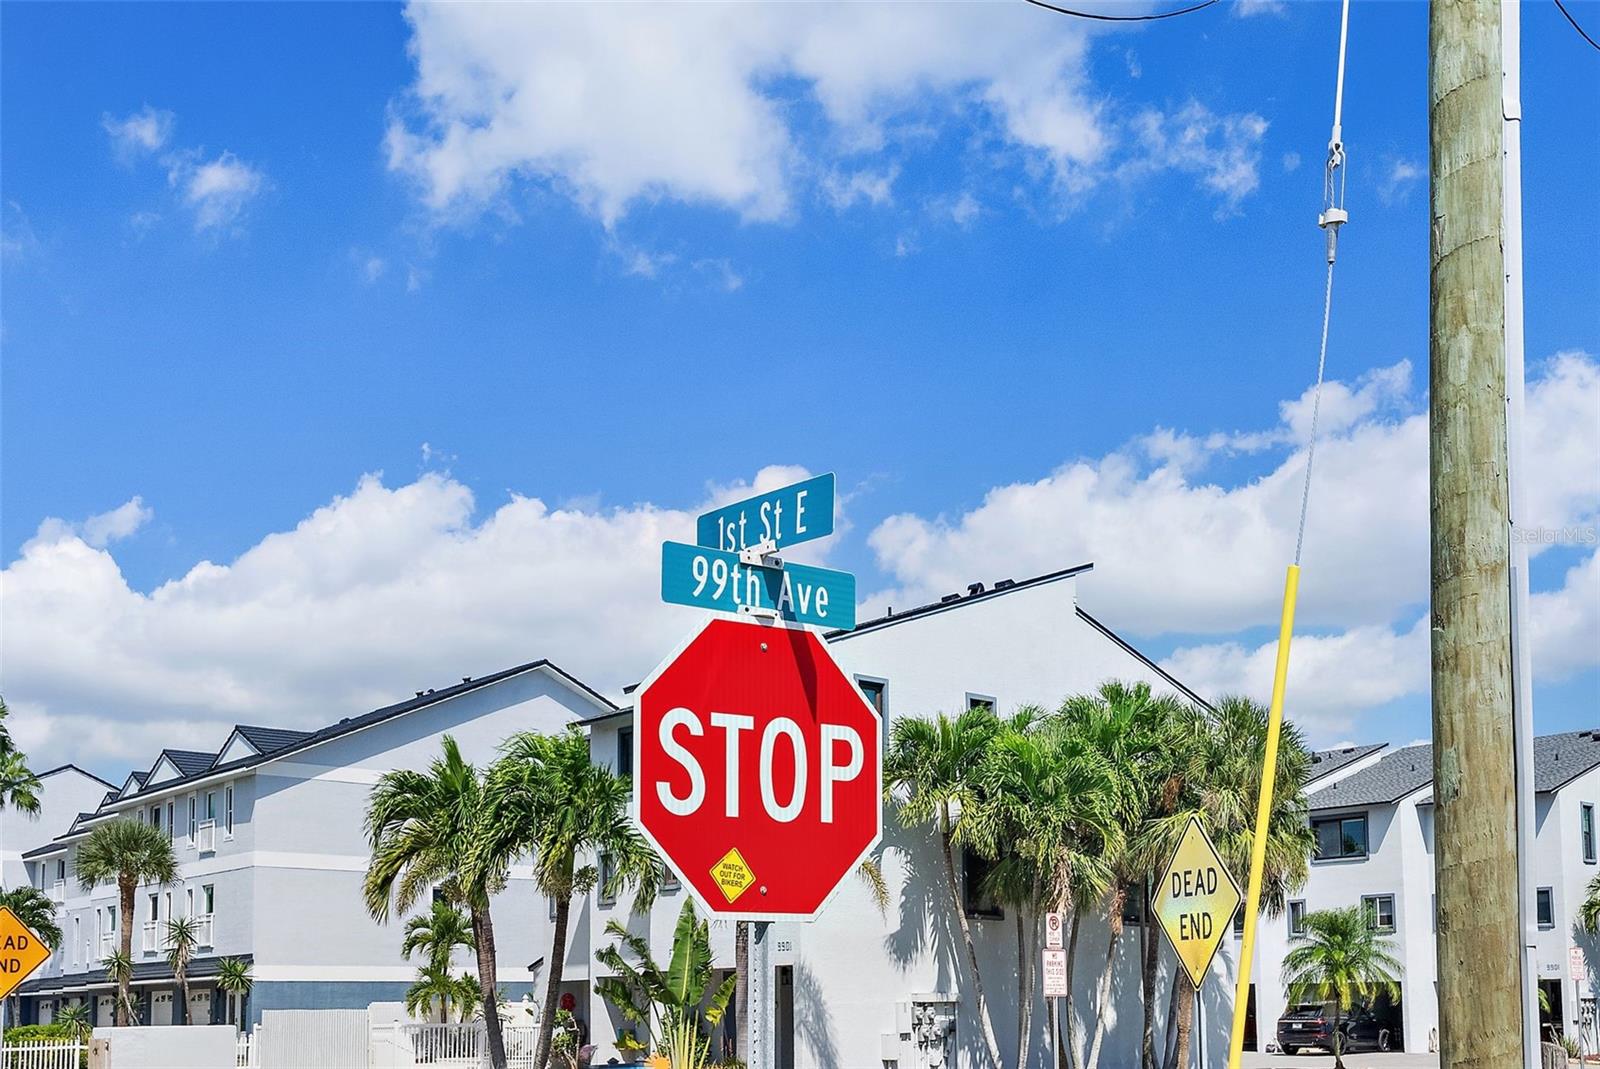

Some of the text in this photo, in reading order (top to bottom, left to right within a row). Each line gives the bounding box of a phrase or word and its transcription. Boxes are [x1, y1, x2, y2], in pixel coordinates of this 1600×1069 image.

[718, 490, 808, 551] 1st St E
[692, 555, 829, 618] 99th Ave
[655, 707, 864, 824] STOP
[719, 870, 746, 881] OUT FOR
[722, 863, 744, 872] WATCH
[721, 878, 743, 888] BIKERS
[1172, 867, 1218, 899] DEAD
[1180, 911, 1213, 941] END
[0, 935, 29, 951] AD
